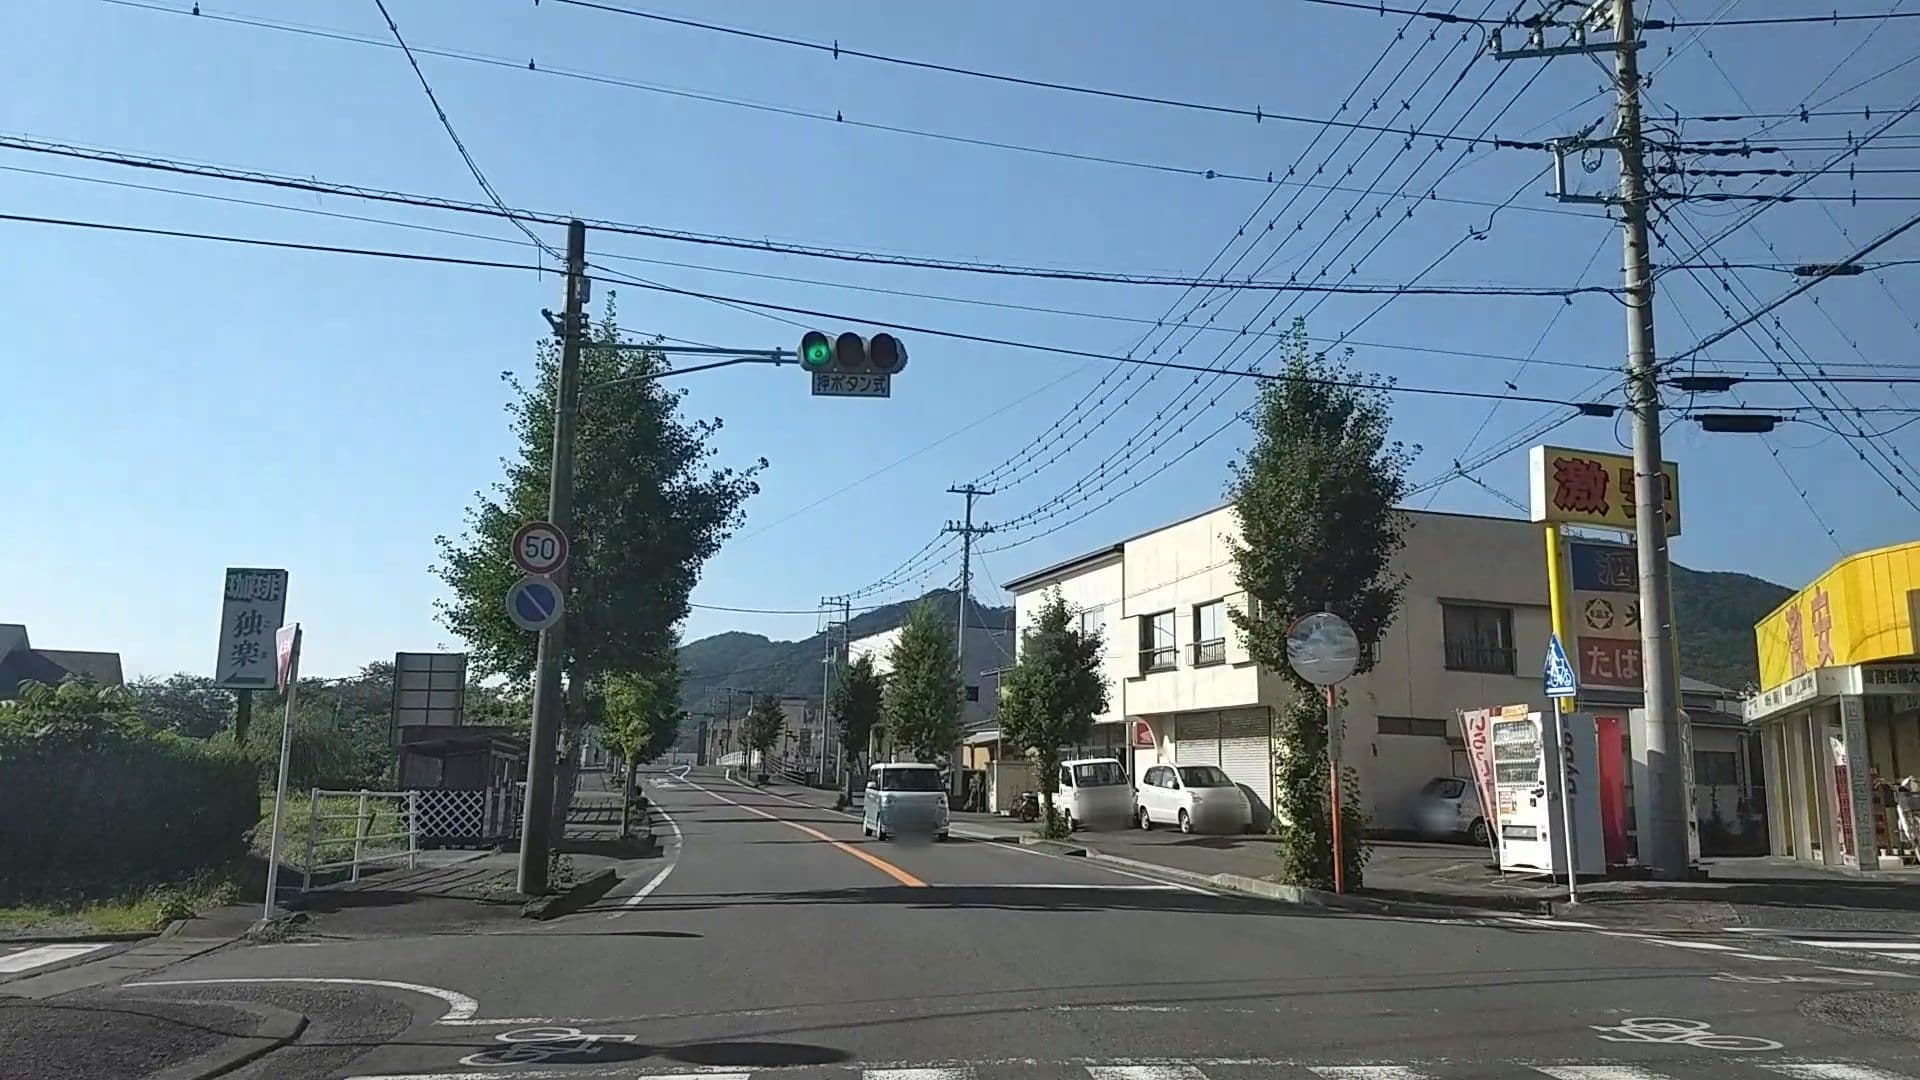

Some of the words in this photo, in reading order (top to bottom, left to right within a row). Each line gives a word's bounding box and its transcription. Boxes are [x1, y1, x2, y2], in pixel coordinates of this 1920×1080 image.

[816, 374, 887, 394] 押ボタン式
[524, 535, 556, 561] 50
[231, 609, 263, 668] 独楽
